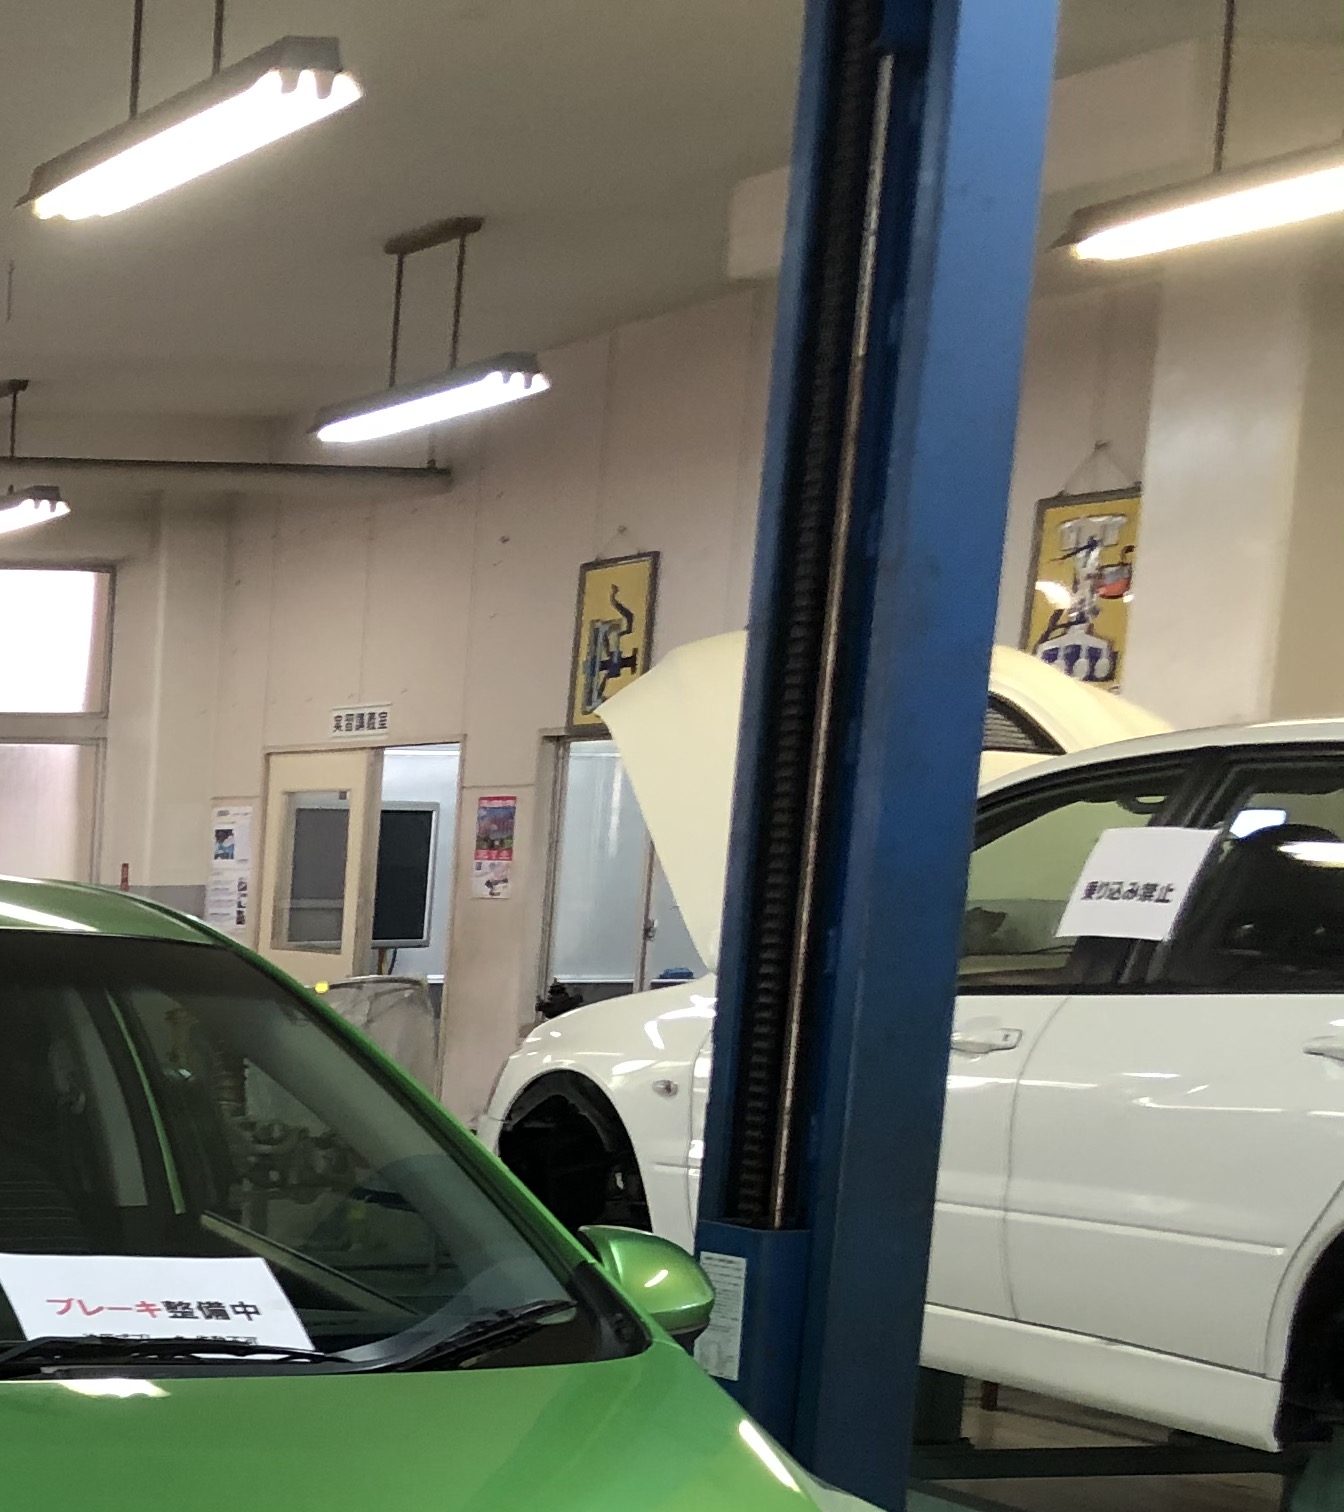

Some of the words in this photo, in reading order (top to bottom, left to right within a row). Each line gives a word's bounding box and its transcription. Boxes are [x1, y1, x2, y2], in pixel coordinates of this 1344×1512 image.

[46, 1297, 262, 1321] ブレーキ整備中
